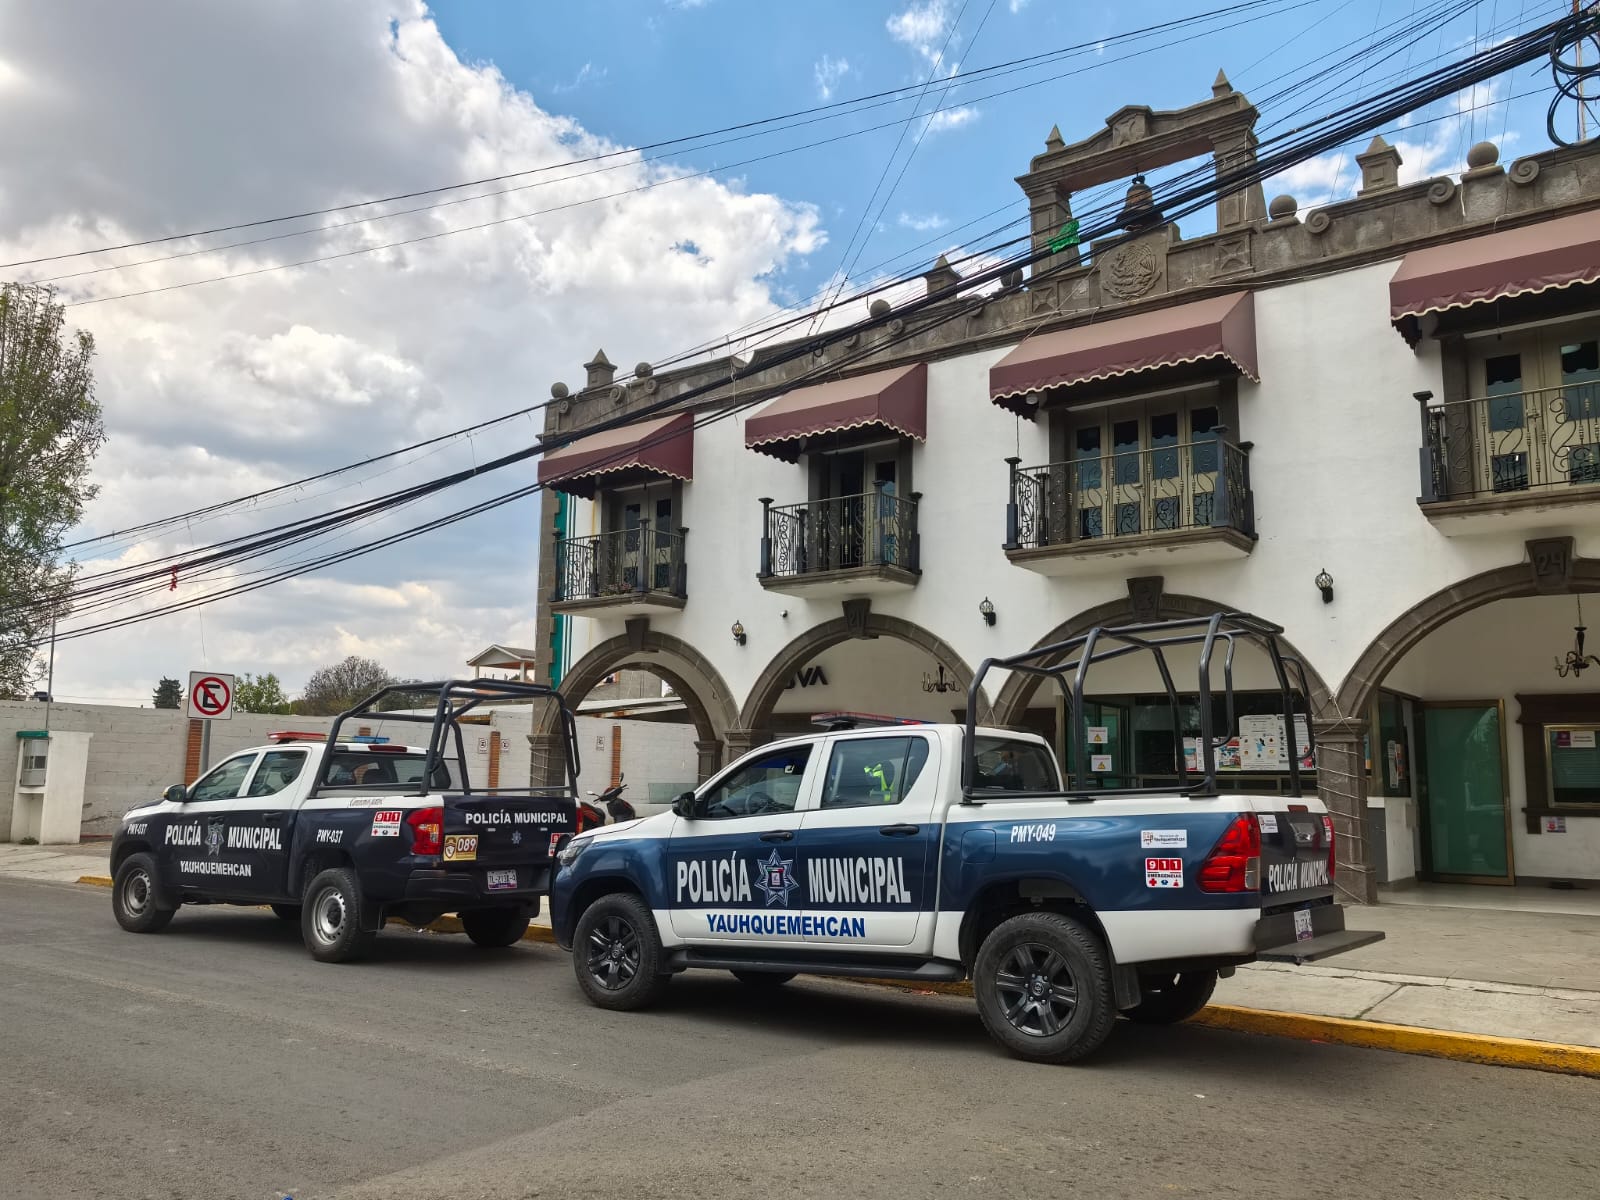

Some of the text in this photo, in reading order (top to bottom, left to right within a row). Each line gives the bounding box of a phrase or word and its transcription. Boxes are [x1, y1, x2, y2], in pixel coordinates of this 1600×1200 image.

[784, 666, 829, 690] VA
[202, 684, 221, 708] E
[376, 813, 398, 821] 911
[465, 809, 568, 825] POLICÍA MUNICIPAL
[164, 820, 282, 850] POLICÍA MUNICIPAL
[316, 829, 343, 843] PMY-037
[1010, 823, 1056, 843] PMY-049
[457, 838, 477, 852] 089
[180, 860, 252, 877] YAUHQUEMEHCAN
[1149, 860, 1178, 870] 911
[1268, 857, 1329, 893] POLICÍA MUNICIPAL
[676, 850, 912, 904] POLICÍA MUNICIPAL
[706, 913, 866, 938] YAUHQUEMEHCAN
